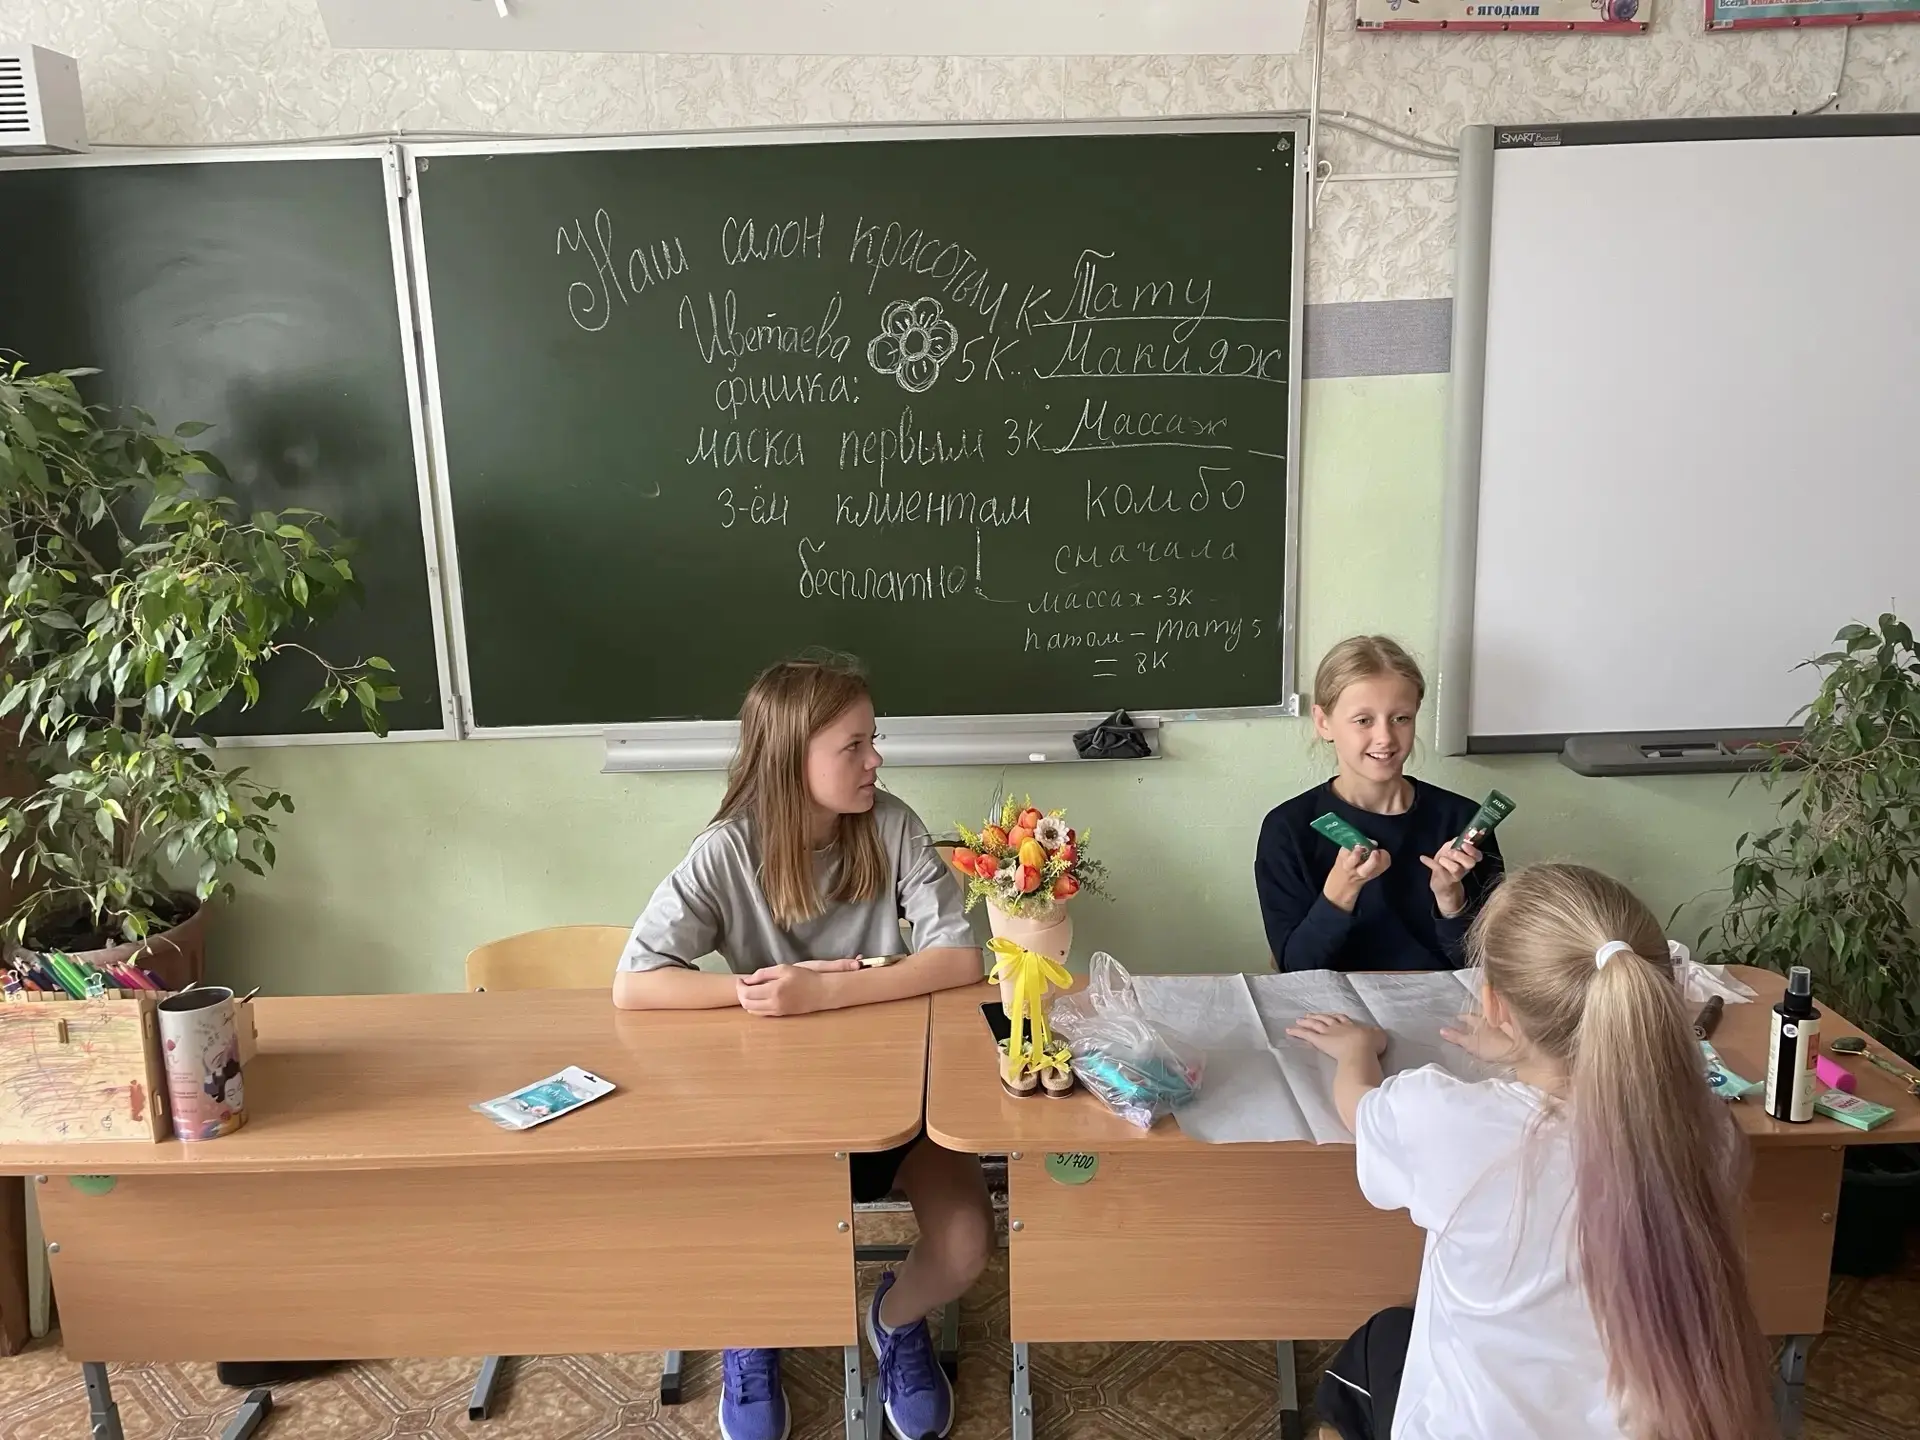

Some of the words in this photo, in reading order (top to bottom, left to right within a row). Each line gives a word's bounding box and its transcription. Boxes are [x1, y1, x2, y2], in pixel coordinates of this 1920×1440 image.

[1477, 4, 1540, 18] ягодами
[1501, 132, 1536, 143] SMART
[557, 208, 689, 331] Наш
[722, 212, 825, 265] салон
[850, 216, 989, 308] красоты
[680, 289, 852, 372] Цветаева
[1034, 323, 1282, 379] Макияж
[715, 372, 860, 420] фишка:
[686, 426, 804, 468] маска
[840, 405, 985, 488] первым
[1053, 398, 1228, 454] Массаж
[836, 490, 1031, 528] клиентам
[1087, 465, 1246, 522] комбо
[1054, 539, 1239, 575] сначала
